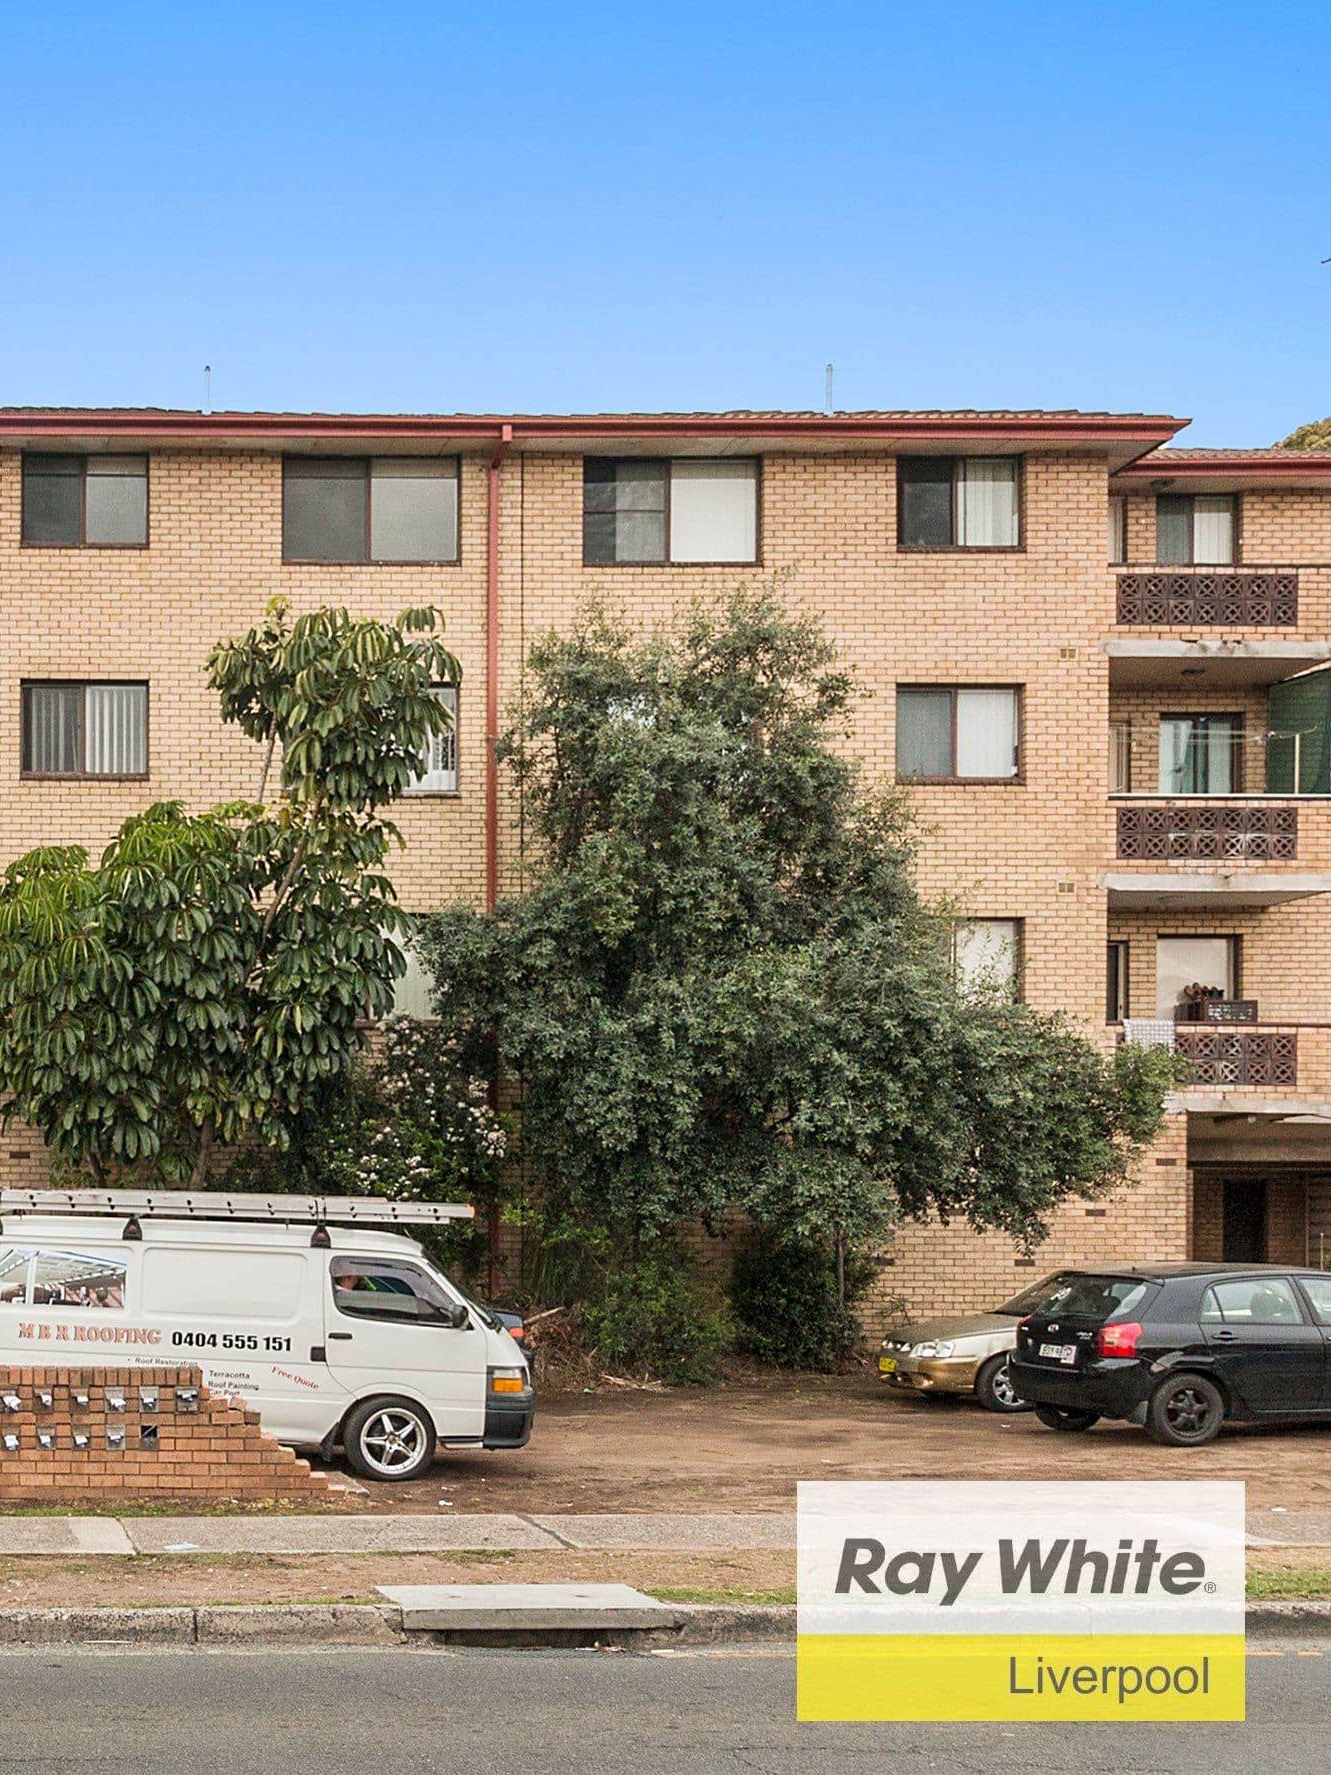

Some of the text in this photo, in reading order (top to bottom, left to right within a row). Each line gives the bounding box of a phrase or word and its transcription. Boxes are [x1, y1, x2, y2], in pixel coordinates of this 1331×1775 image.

[19, 1322, 162, 1345] M B R ROOFING
[172, 1331, 291, 1352] 0404 555 151
[209, 1370, 250, 1379] Terracotta
[271, 1365, 320, 1390] Free Quote
[208, 1380, 259, 1391] Roof Painting
